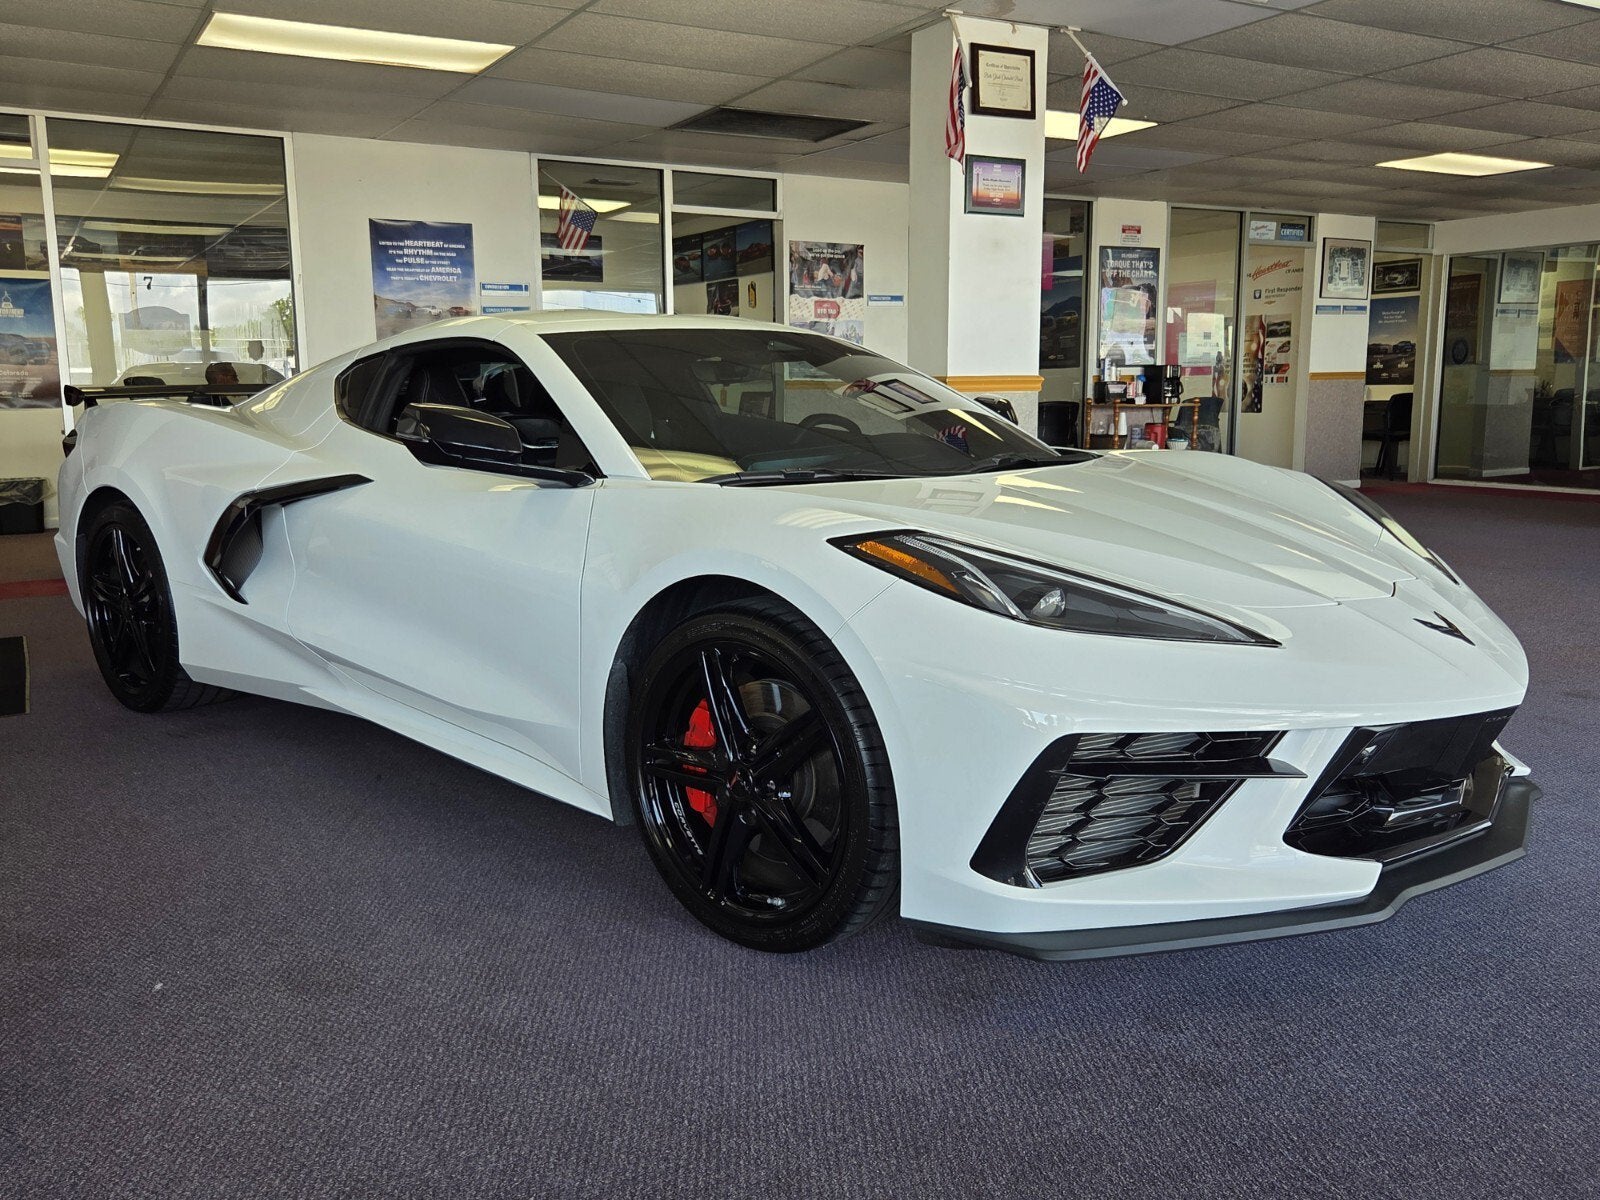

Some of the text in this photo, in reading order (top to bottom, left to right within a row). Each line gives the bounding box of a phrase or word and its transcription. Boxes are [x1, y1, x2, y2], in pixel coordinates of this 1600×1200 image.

[1106, 260, 1130, 268] TORQUE
[1252, 258, 1293, 281] Heartbeat
[1131, 270, 1154, 278] CHART.
[144, 276, 152, 290] 7
[674, 802, 703, 855] CORVETTE
